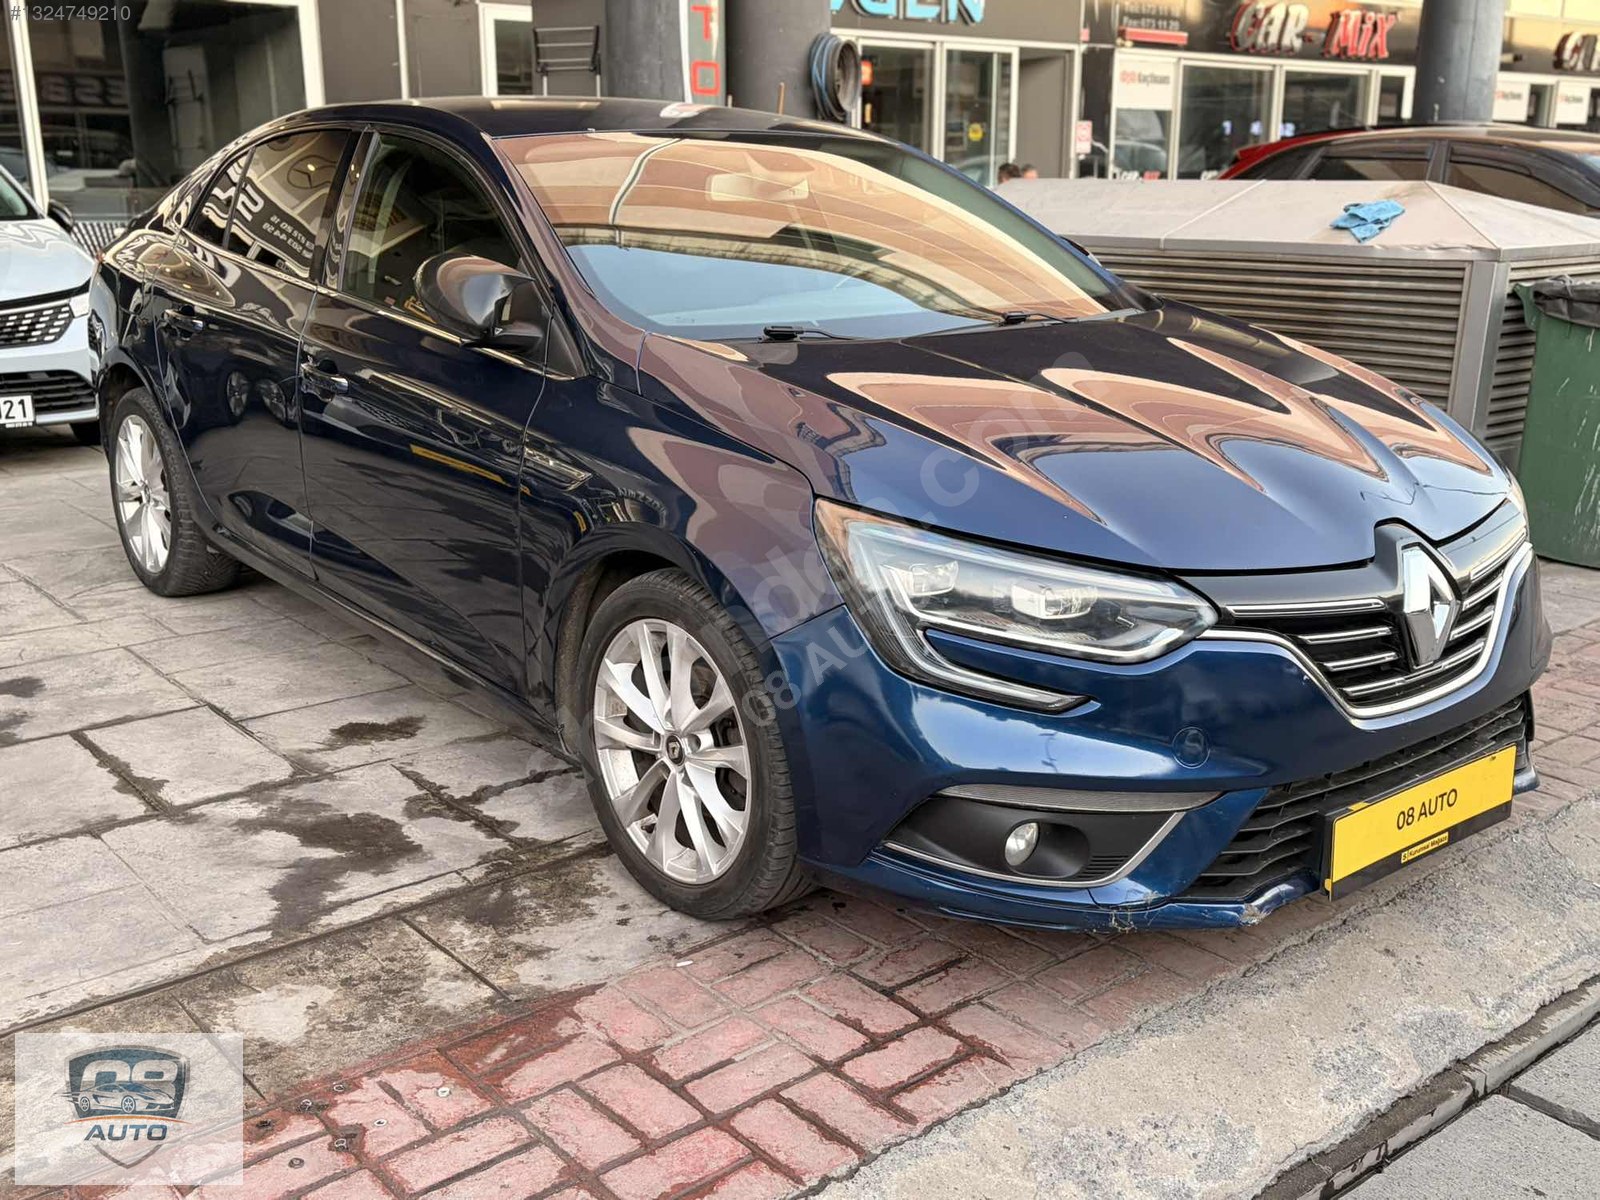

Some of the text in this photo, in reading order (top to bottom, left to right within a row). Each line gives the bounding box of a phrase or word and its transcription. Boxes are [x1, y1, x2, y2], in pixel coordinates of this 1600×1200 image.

[1231, 0, 1309, 53] CAR
[1396, 788, 1458, 830] 08 AUTO
